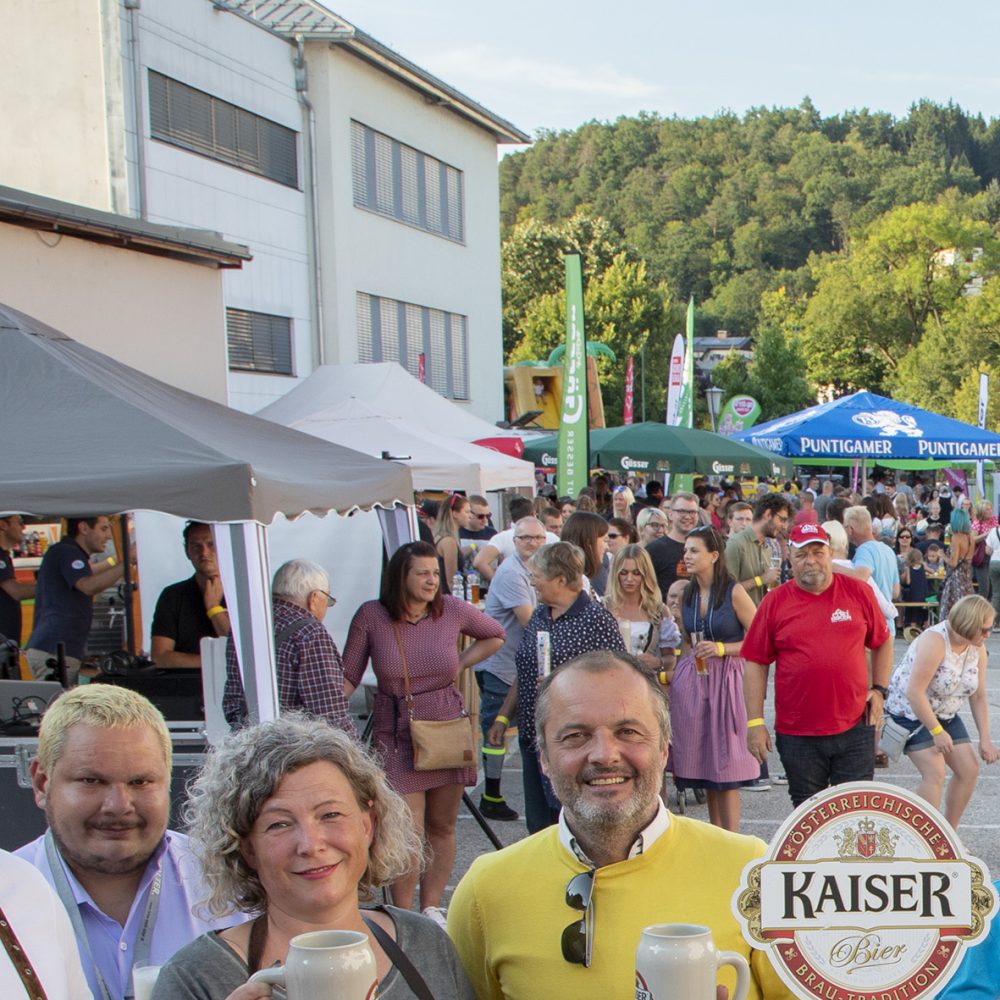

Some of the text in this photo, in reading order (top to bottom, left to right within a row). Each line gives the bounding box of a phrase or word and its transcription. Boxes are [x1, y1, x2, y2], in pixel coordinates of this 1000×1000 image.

[541, 453, 558, 465] Göss
[800, 437, 892, 454] PUNTIGAMER
[621, 456, 649, 469] Gösser
[789, 795, 942, 845] ÖSTERREICHISCHE
[781, 871, 955, 919] KAISER
[829, 934, 907, 975] Bier
